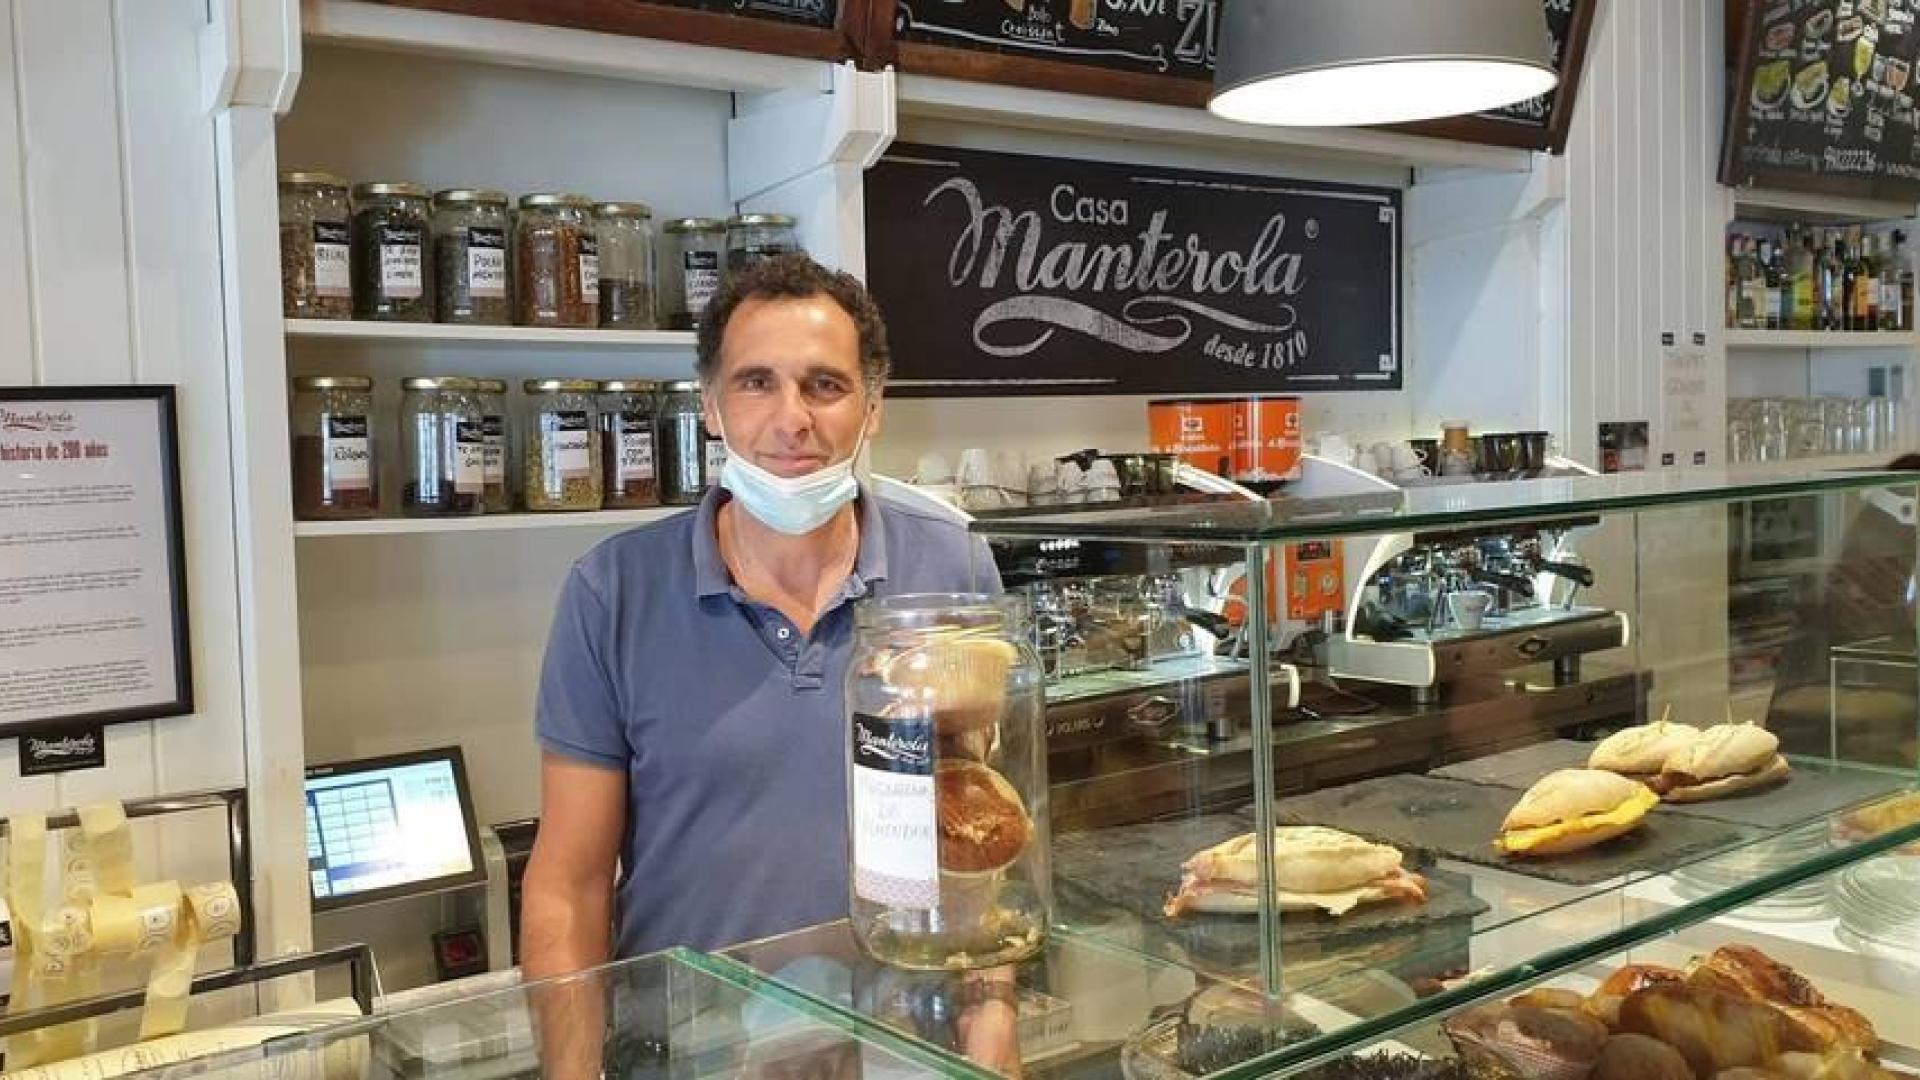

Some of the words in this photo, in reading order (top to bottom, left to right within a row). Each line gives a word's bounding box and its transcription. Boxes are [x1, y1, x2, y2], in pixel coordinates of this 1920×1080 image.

[1050, 184, 1129, 226] Casa
[924, 177, 1304, 296] Manterola
[1203, 334, 1256, 368] desde
[1260, 330, 1307, 369] 1810
